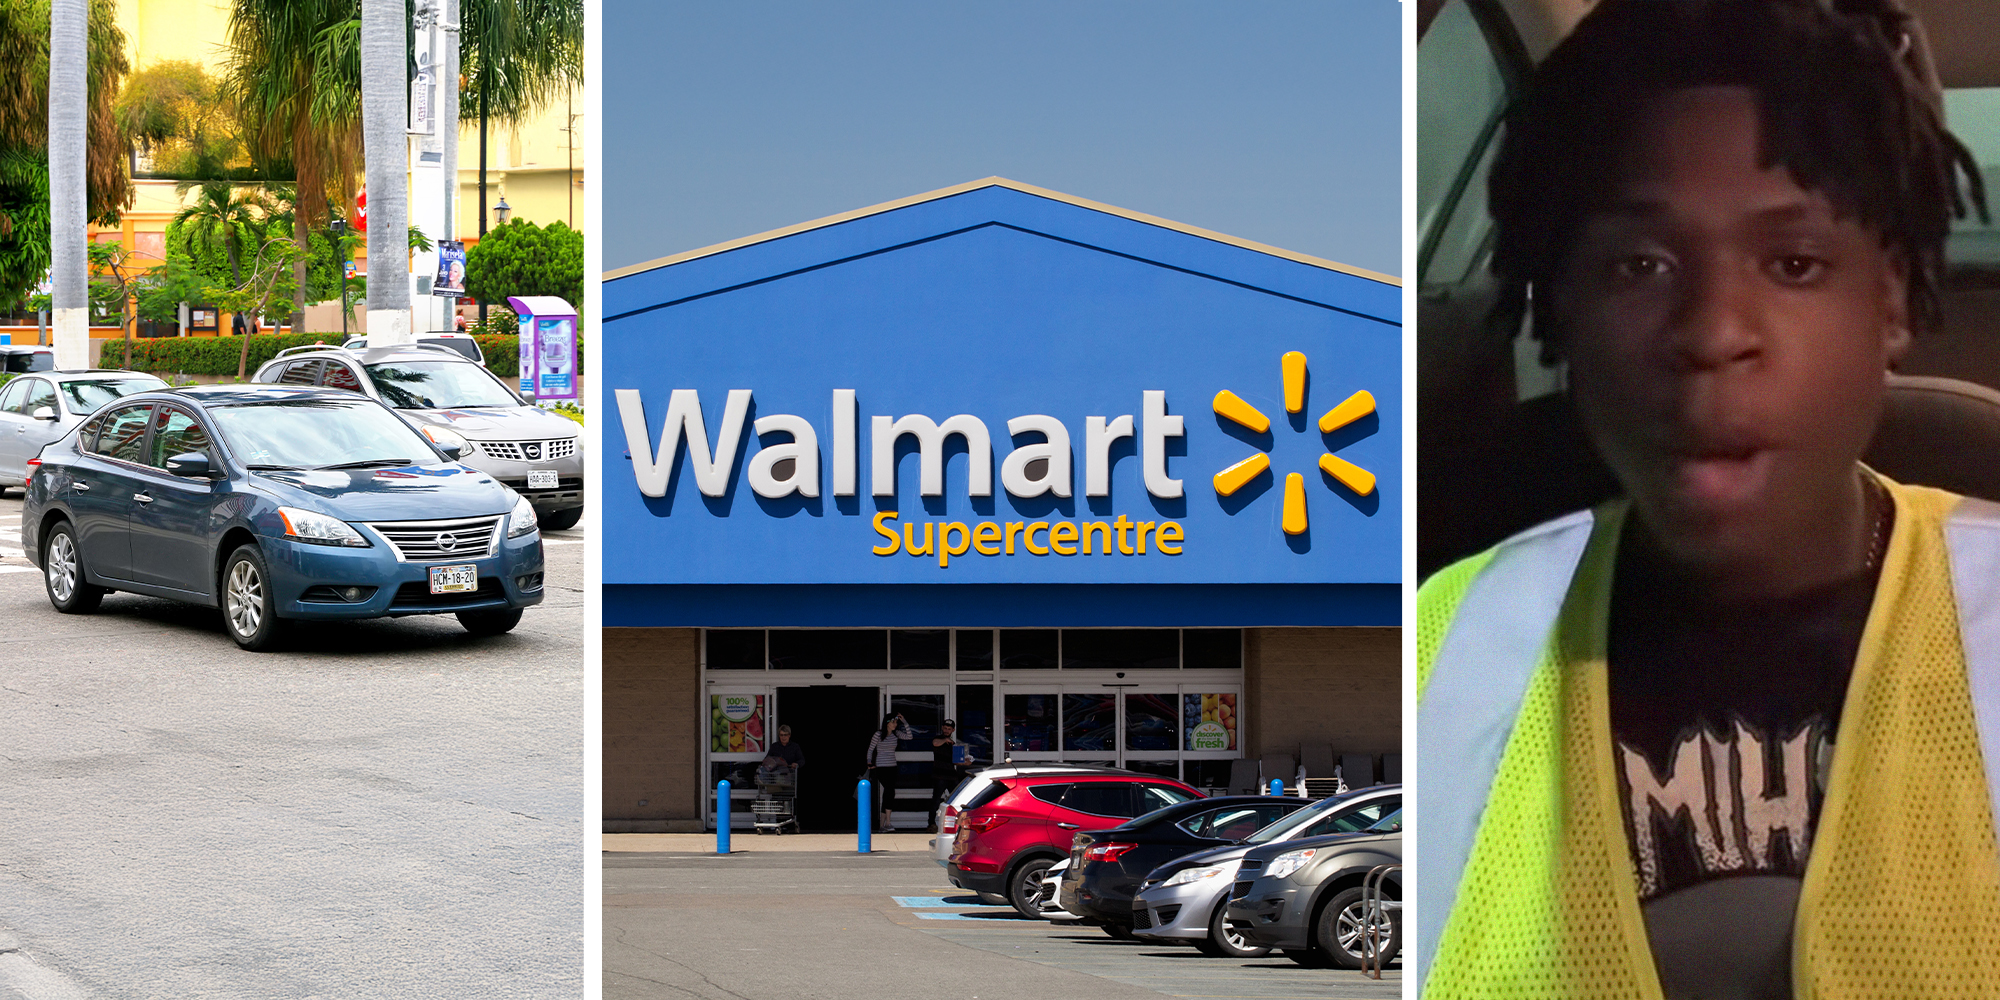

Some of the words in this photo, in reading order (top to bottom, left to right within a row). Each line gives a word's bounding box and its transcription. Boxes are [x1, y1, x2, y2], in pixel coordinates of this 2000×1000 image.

[614, 388, 1184, 498] Walmart
[872, 510, 1185, 567] Supercentre
[1196, 738, 1224, 748] fresh
